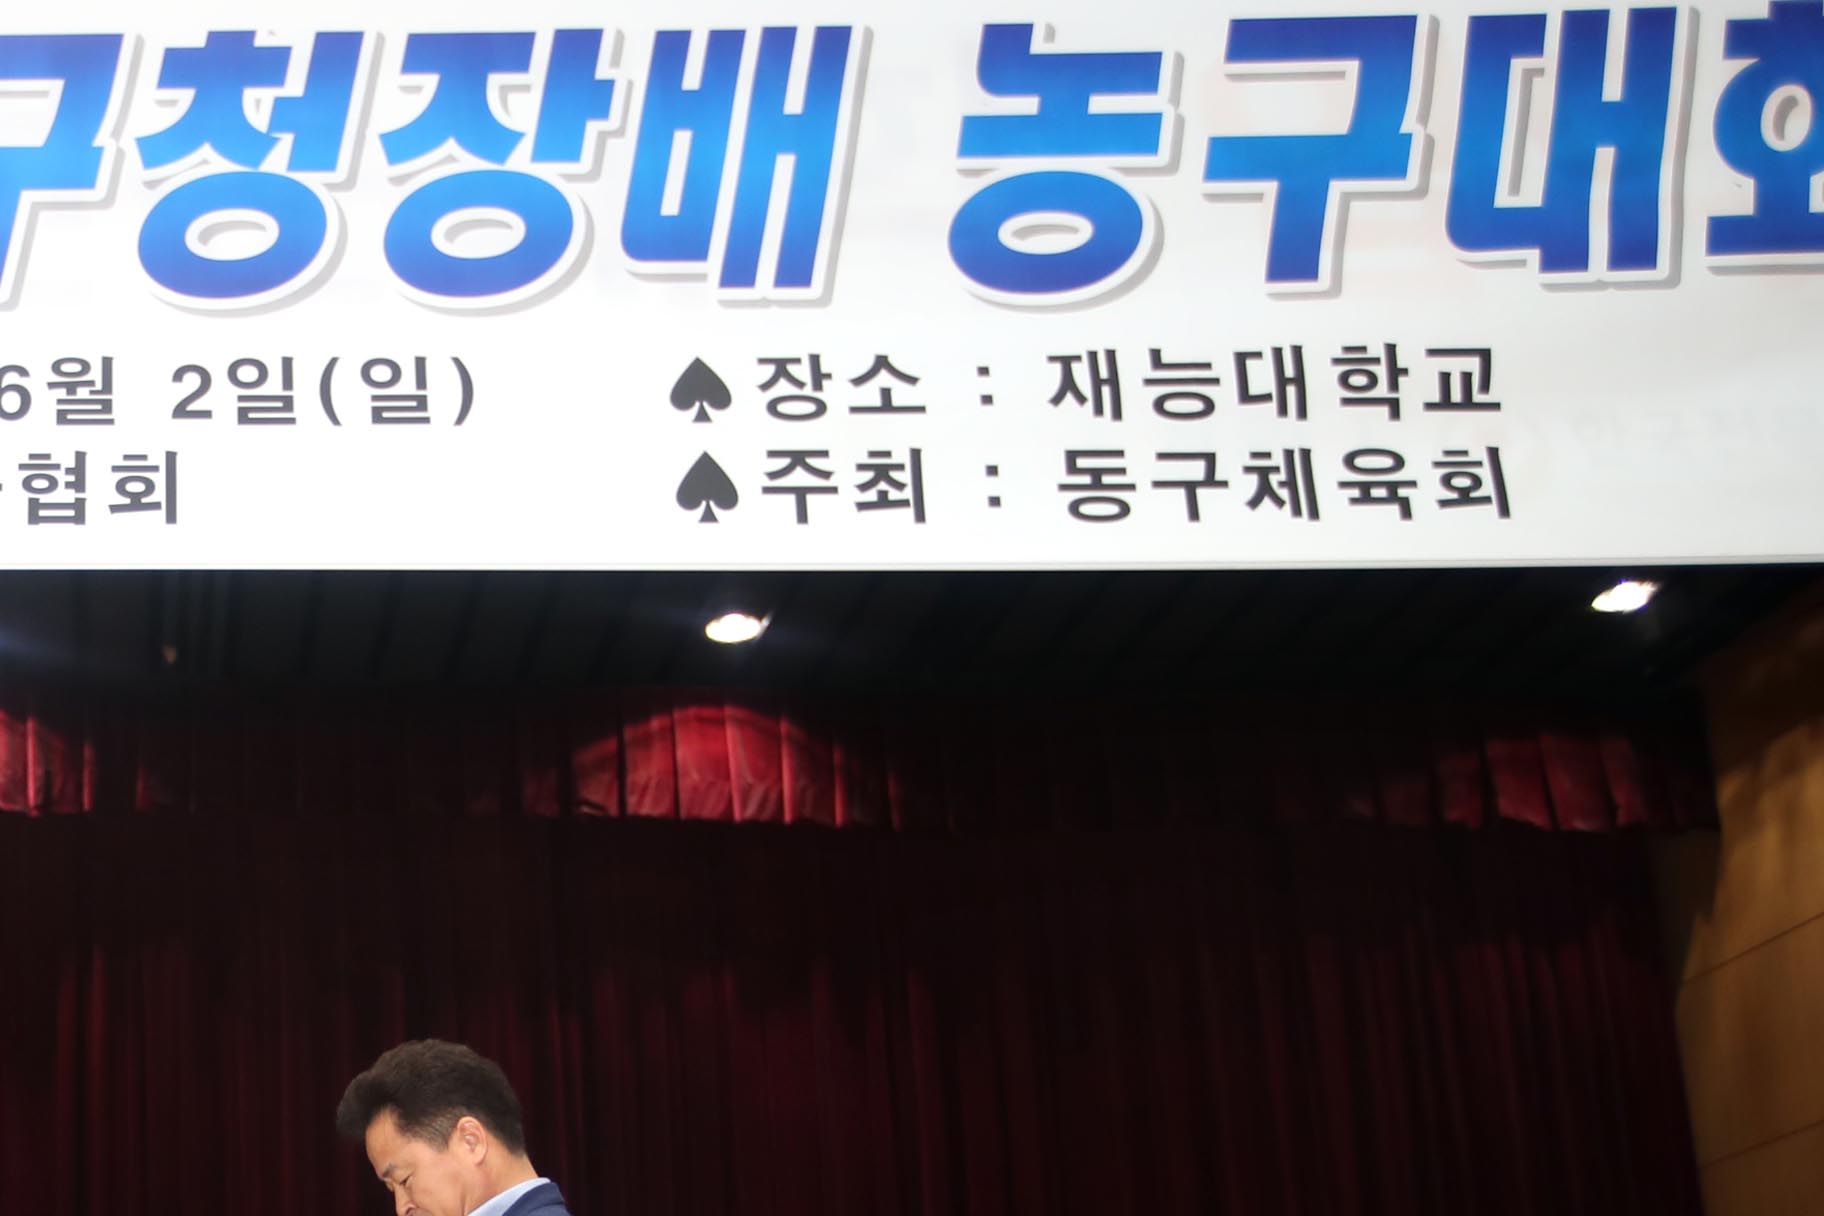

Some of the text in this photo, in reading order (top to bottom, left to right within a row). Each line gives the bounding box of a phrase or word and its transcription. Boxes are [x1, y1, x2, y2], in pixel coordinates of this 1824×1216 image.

[171, 355, 475, 427] 2일(일)
[756, 353, 927, 421] 장소
[1046, 342, 1503, 421] 재능대학교
[761, 447, 927, 524] 주최
[1057, 445, 1512, 522] 동구체육회
